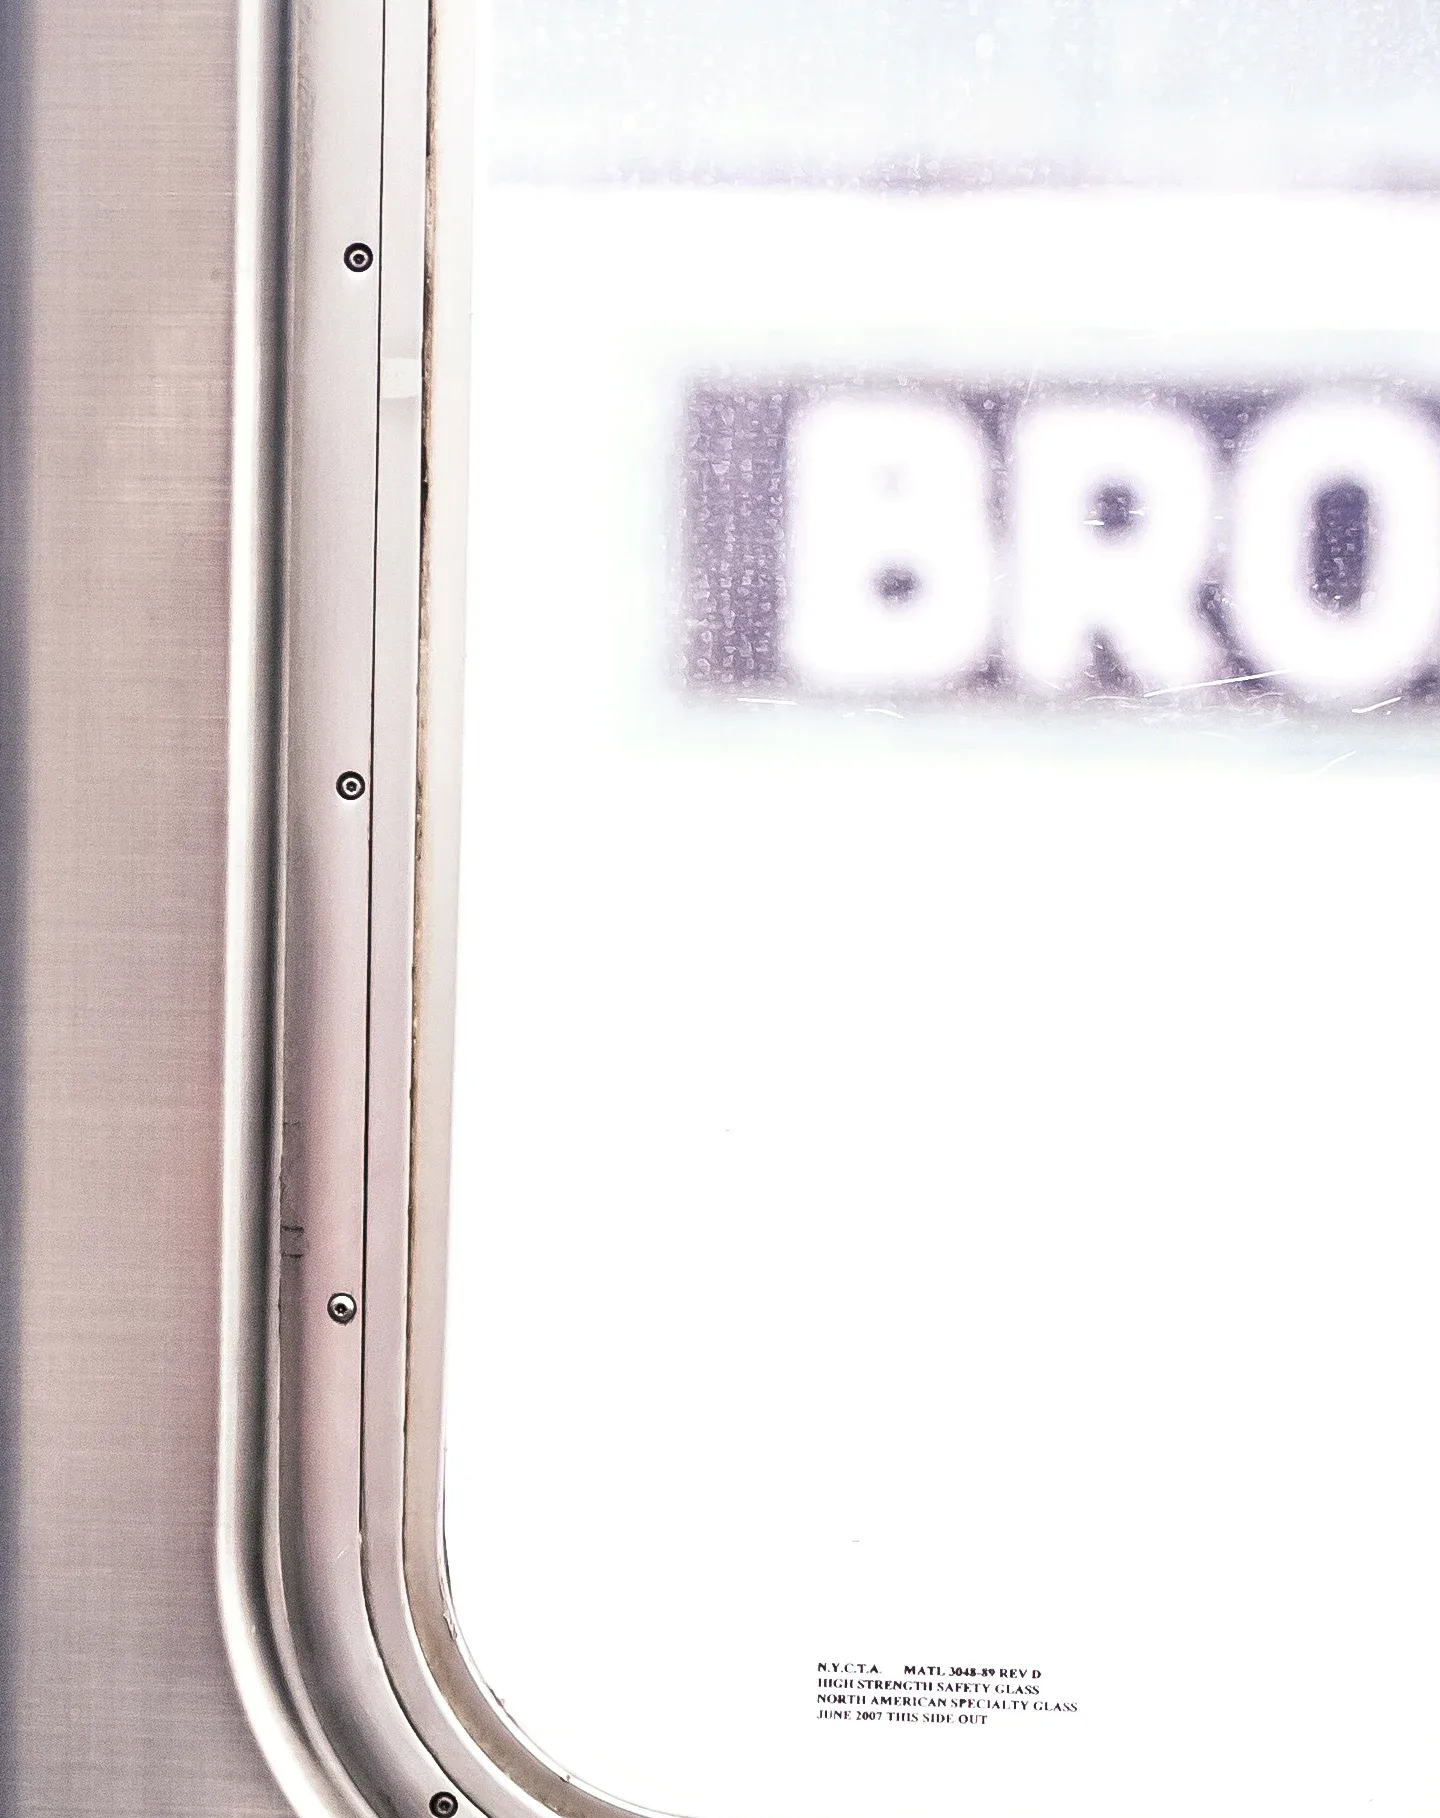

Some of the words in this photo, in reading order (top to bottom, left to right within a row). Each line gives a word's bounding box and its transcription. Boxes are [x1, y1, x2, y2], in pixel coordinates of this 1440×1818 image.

[817, 1662, 883, 1674] N.Y.C.T.A.
[999, 1668, 1028, 1679] REV
[1031, 1669, 1042, 1680] D
[817, 1678, 855, 1689] HIGH
[857, 1680, 933, 1691] STRENGTH
[937, 1682, 991, 1694] SAFETY
[994, 1684, 1040, 1695] GLASS
[817, 1694, 867, 1705] NORTH
[870, 1695, 948, 1708] AMERICAN
[950, 1698, 1029, 1711] SPECIALTY
[1033, 1701, 1079, 1713] GLASS
[817, 1710, 853, 1721] JUNE
[855, 1711, 883, 1721] 2007
[886, 1712, 919, 1722] THIS
[922, 1713, 954, 1724] SIDE
[958, 1714, 989, 1725] OUT
